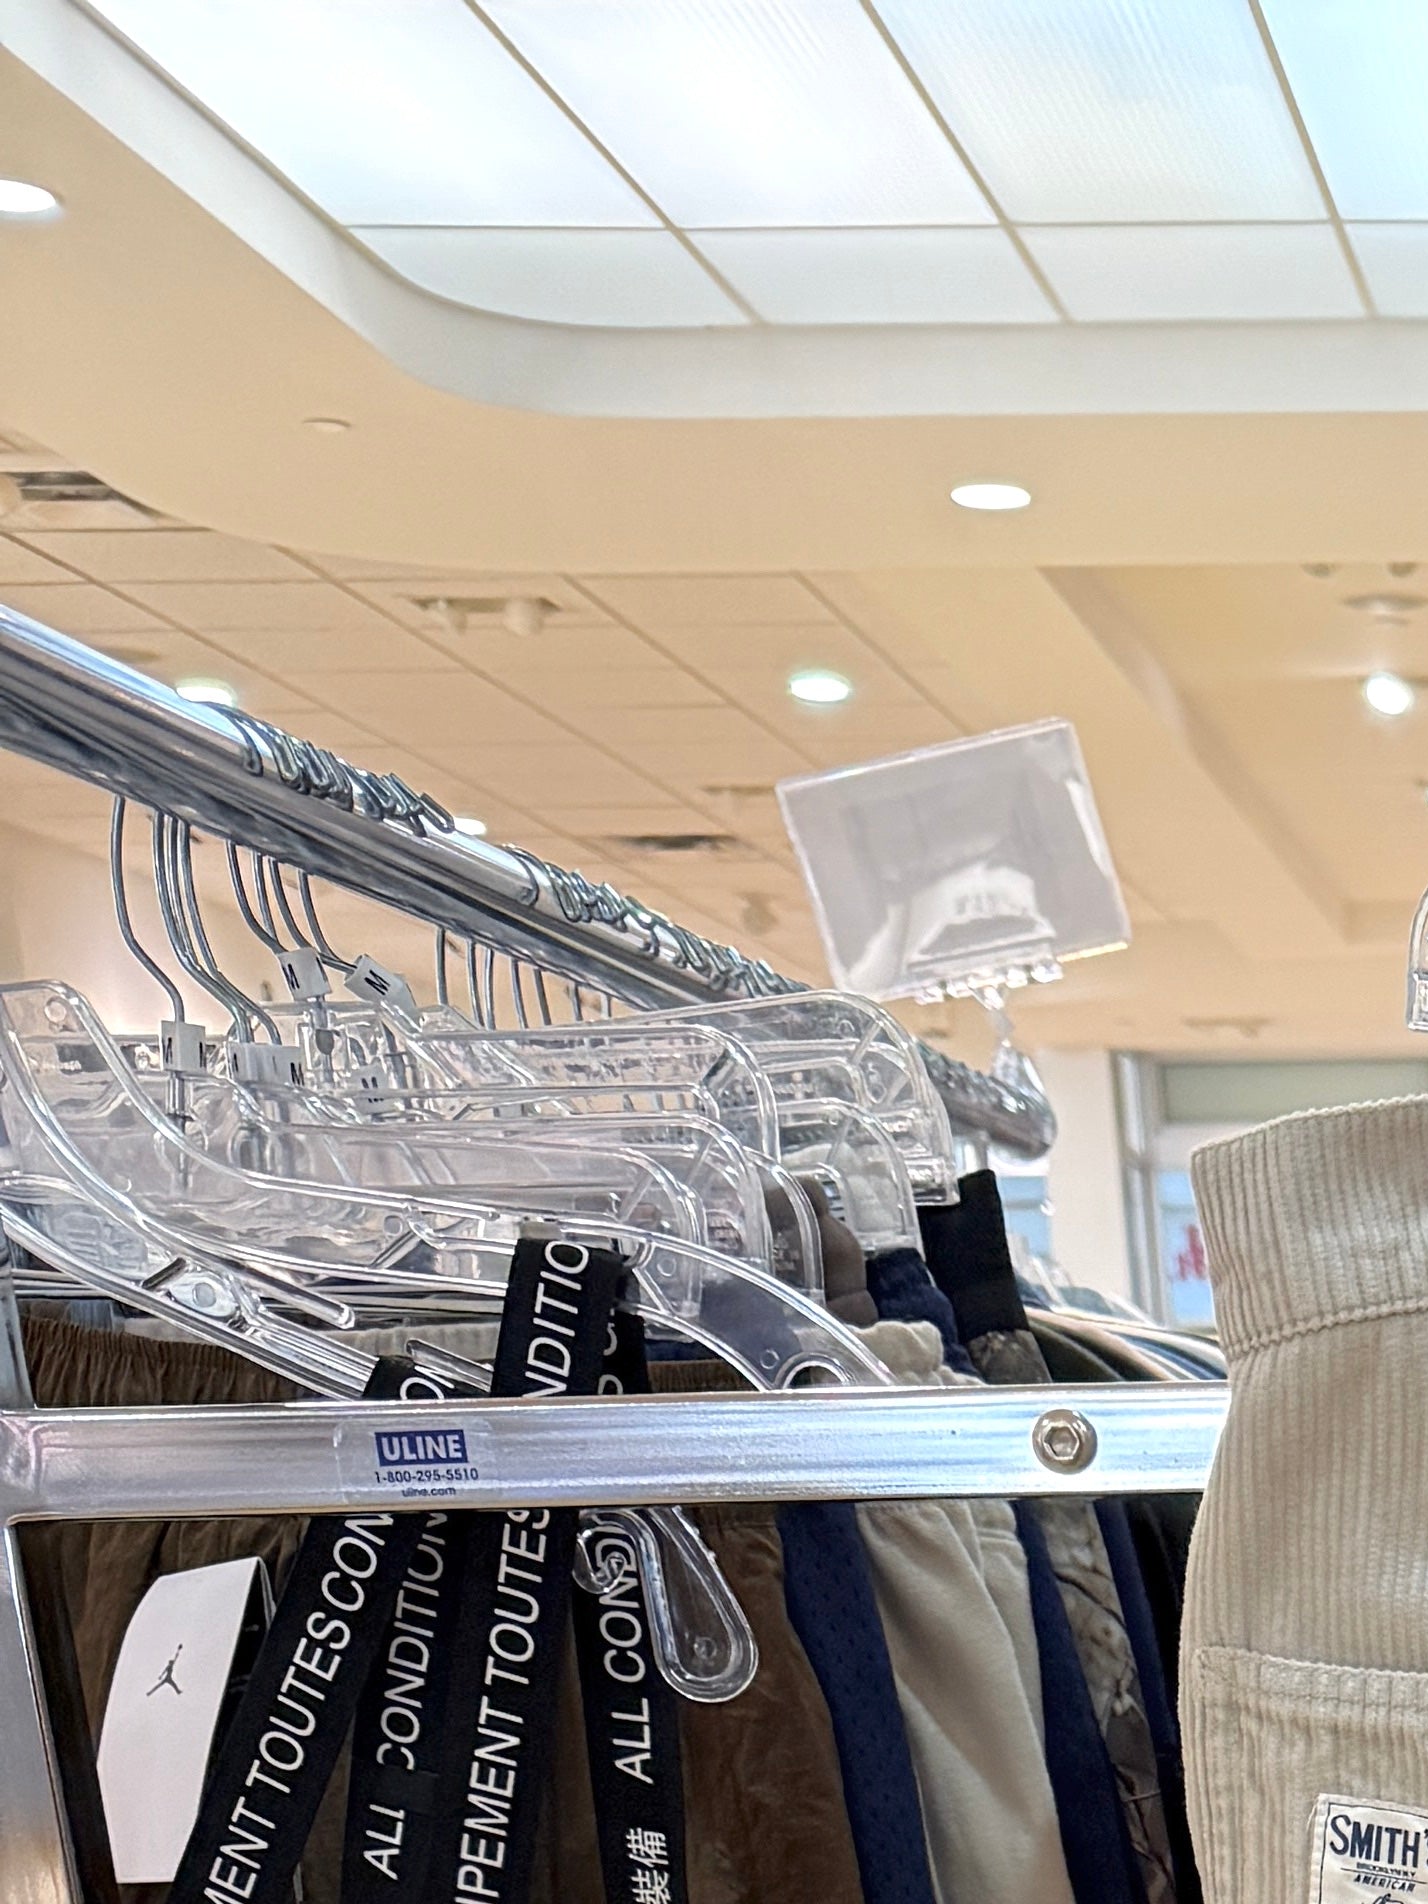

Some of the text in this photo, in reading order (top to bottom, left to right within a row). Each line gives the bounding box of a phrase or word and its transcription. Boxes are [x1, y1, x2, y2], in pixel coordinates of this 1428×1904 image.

[364, 969, 391, 996] M
[380, 1433, 463, 1462] ULINE
[375, 1467, 479, 1483] 1-800-295-5510
[402, 1486, 457, 1497] uline.com
[245, 1610, 351, 1795] TOUTES
[611, 1697, 655, 1785] ALL
[1353, 1874, 1416, 1893] AMERICAN
